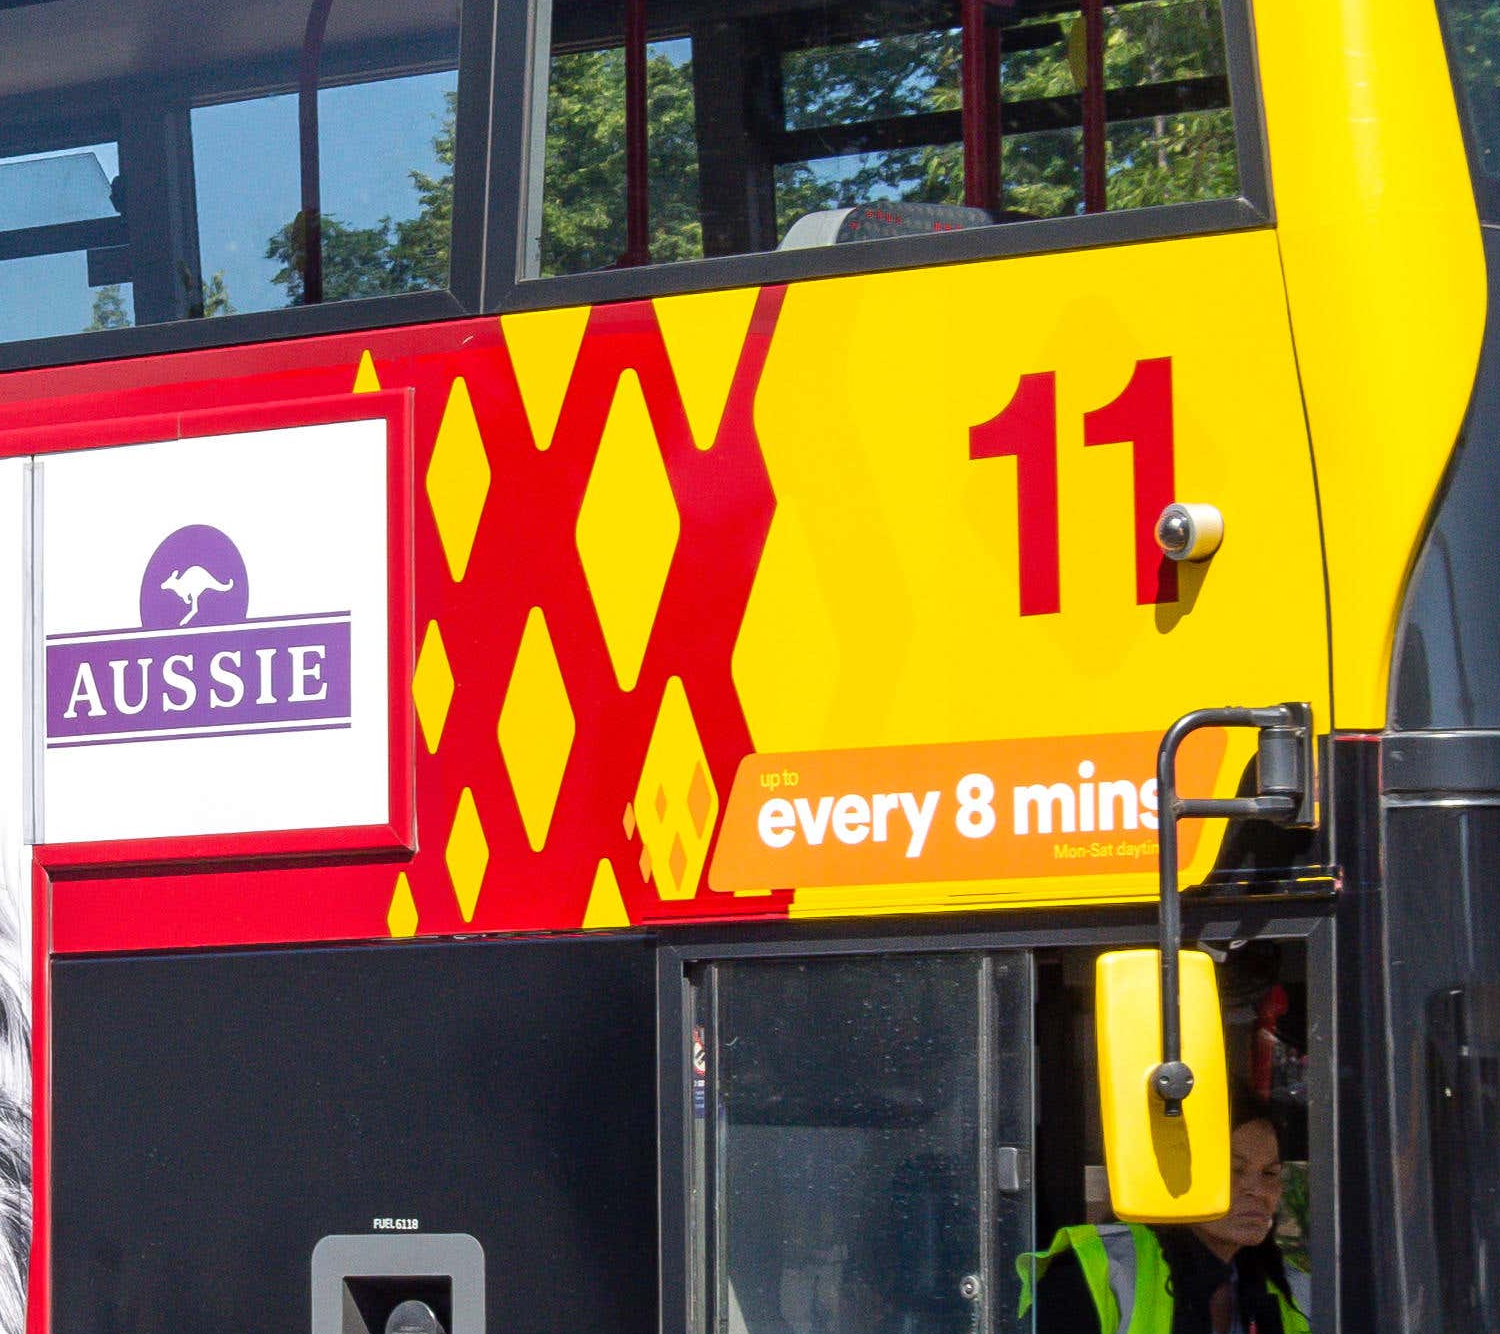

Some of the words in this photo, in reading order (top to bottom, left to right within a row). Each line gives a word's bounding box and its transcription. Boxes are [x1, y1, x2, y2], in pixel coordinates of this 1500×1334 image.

[969, 356, 1178, 617] 11
[63, 644, 329, 720] AUSSIE
[760, 772, 781, 793] up
[783, 769, 799, 787] to
[757, 790, 942, 859] every
[955, 773, 997, 839] 8
[1013, 759, 1160, 836] mins
[1053, 842, 1113, 859] Mon-Sat
[373, 1218, 395, 1230] FUEL
[395, 1218, 419, 1230] 6118
